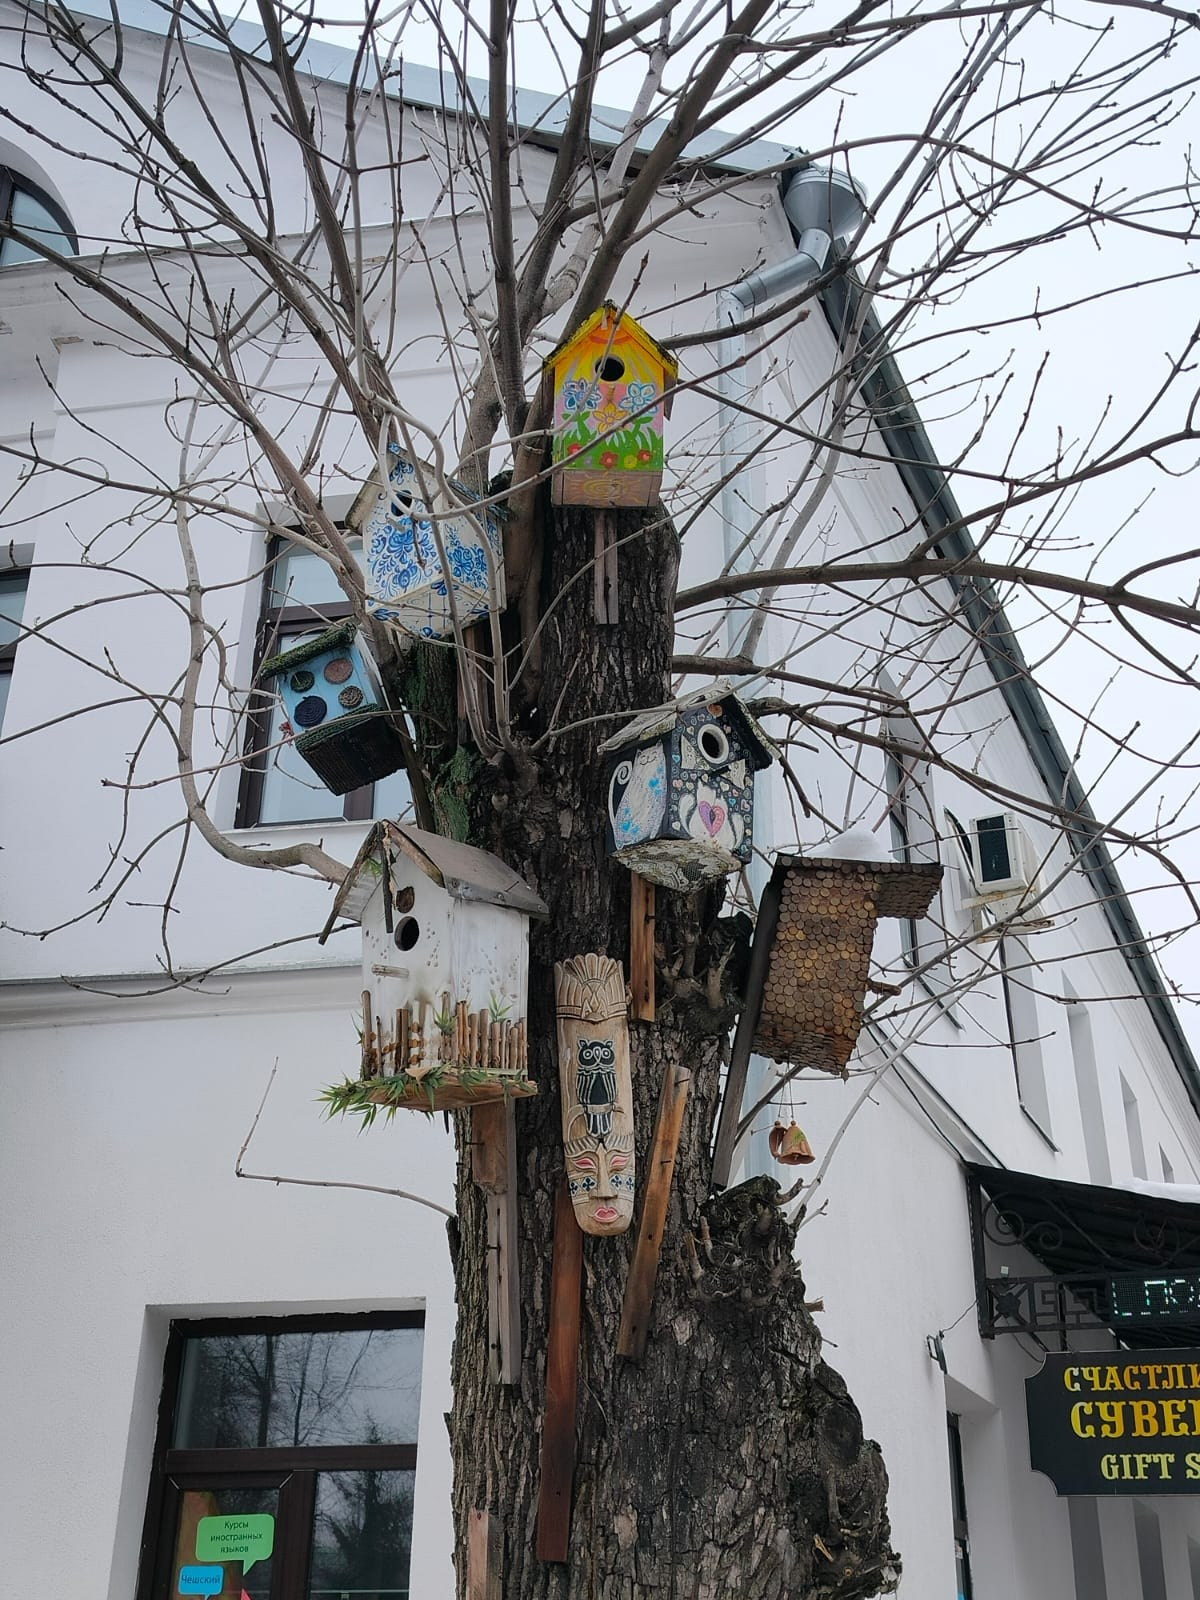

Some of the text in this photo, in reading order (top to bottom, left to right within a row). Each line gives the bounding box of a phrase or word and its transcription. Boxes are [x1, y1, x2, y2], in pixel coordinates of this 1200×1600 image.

[1100, 1453, 1175, 1480] GIFT
[224, 1520, 249, 1531] Курсы
[210, 1532, 263, 1543] иностранных
[220, 1545, 249, 1554] языков
[181, 1574, 221, 1584] Чешский
